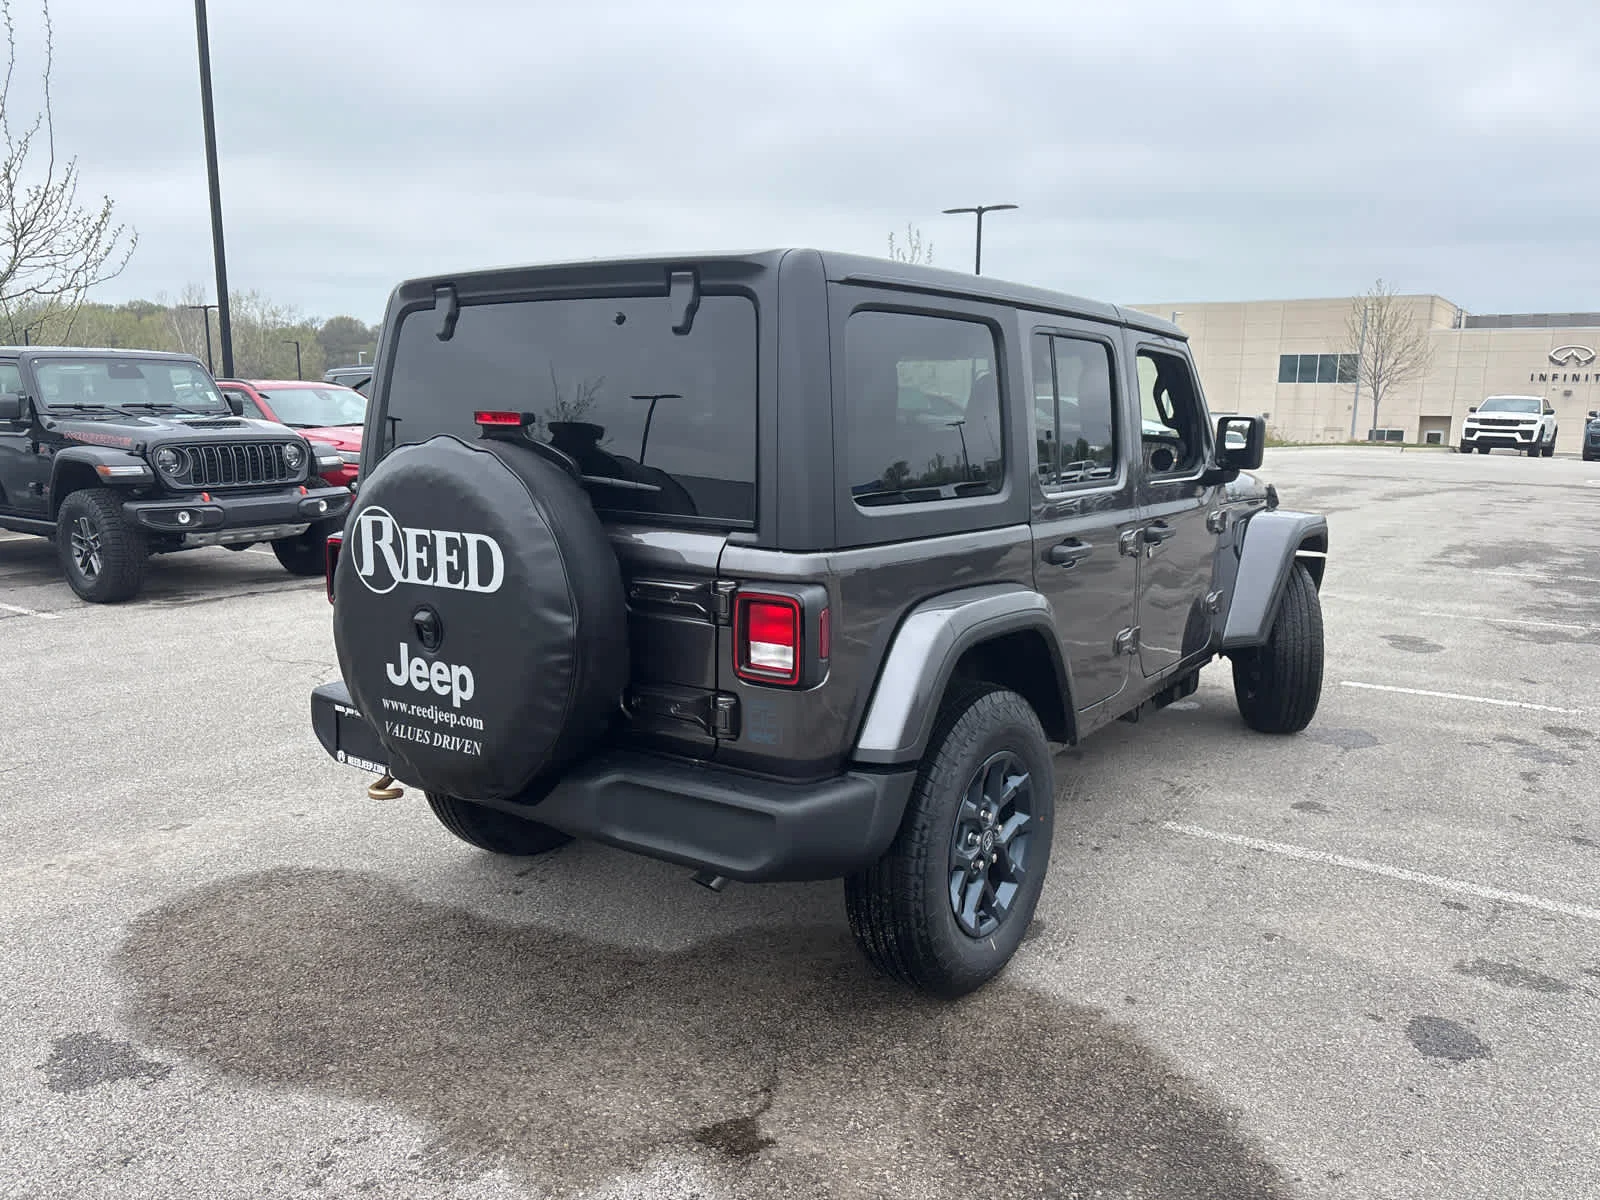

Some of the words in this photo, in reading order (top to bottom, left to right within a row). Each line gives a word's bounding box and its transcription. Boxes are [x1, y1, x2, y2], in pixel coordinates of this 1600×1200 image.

[360, 515, 505, 593] REED
[386, 642, 475, 708] Jeep
[382, 698, 484, 731] www.reedjeep.com
[385, 720, 431, 745] VALUES
[432, 732, 482, 757] DRIVEN
